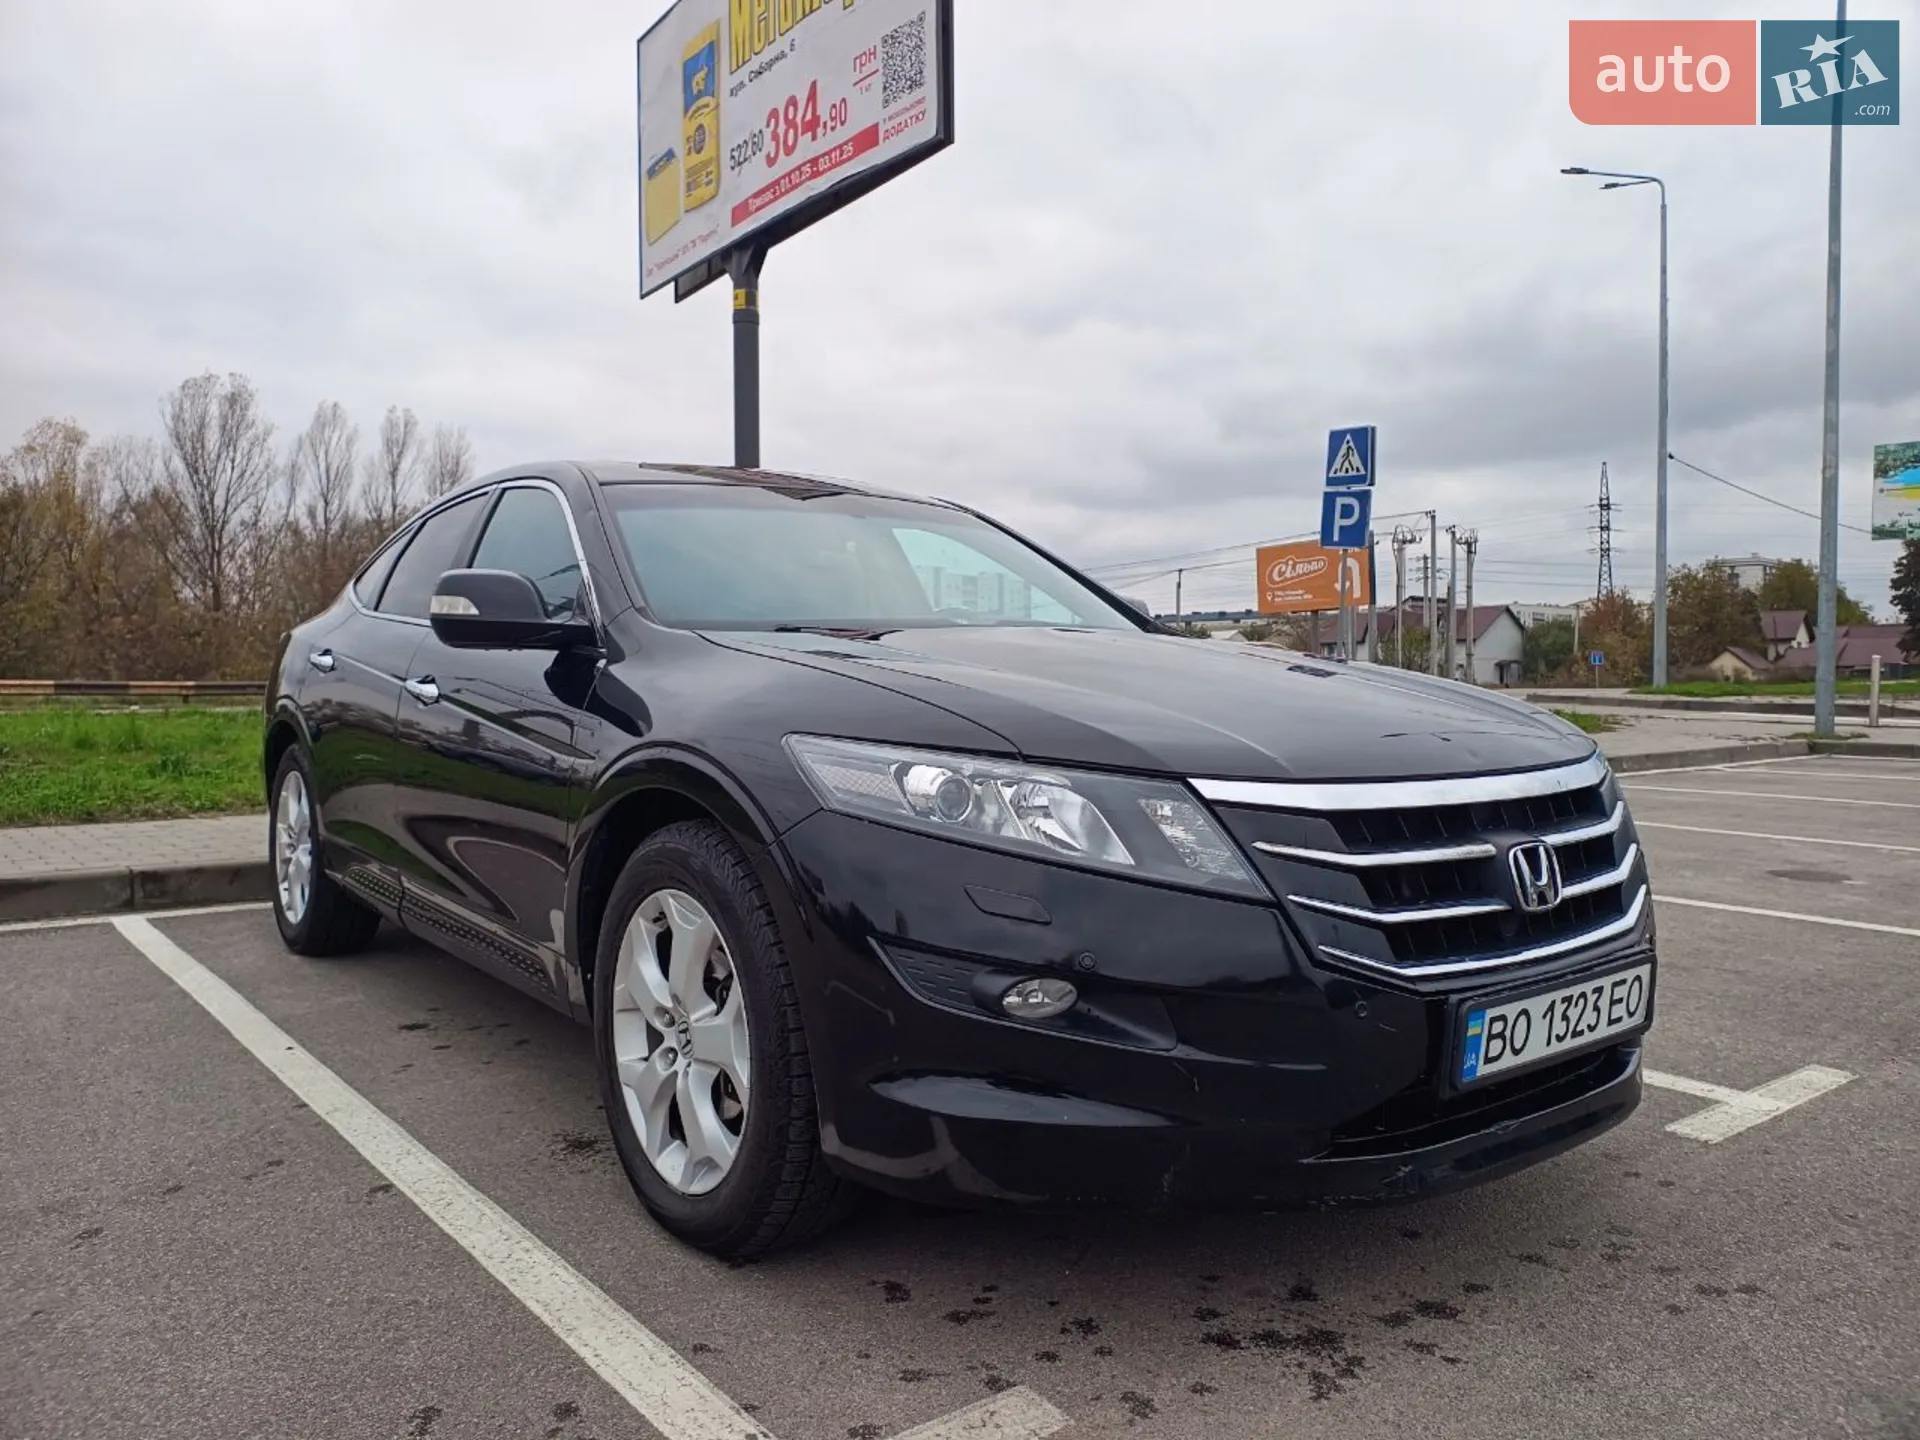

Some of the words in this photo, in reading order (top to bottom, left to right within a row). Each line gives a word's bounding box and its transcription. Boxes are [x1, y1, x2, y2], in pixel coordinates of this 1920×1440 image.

[853, 44, 877, 74] грн
[1333, 496, 1360, 542] P
[1272, 558, 1325, 582] Сільпо
[1483, 1007, 1532, 1066] BO
[1542, 985, 1604, 1047] 1323
[1606, 974, 1643, 1027] EO
